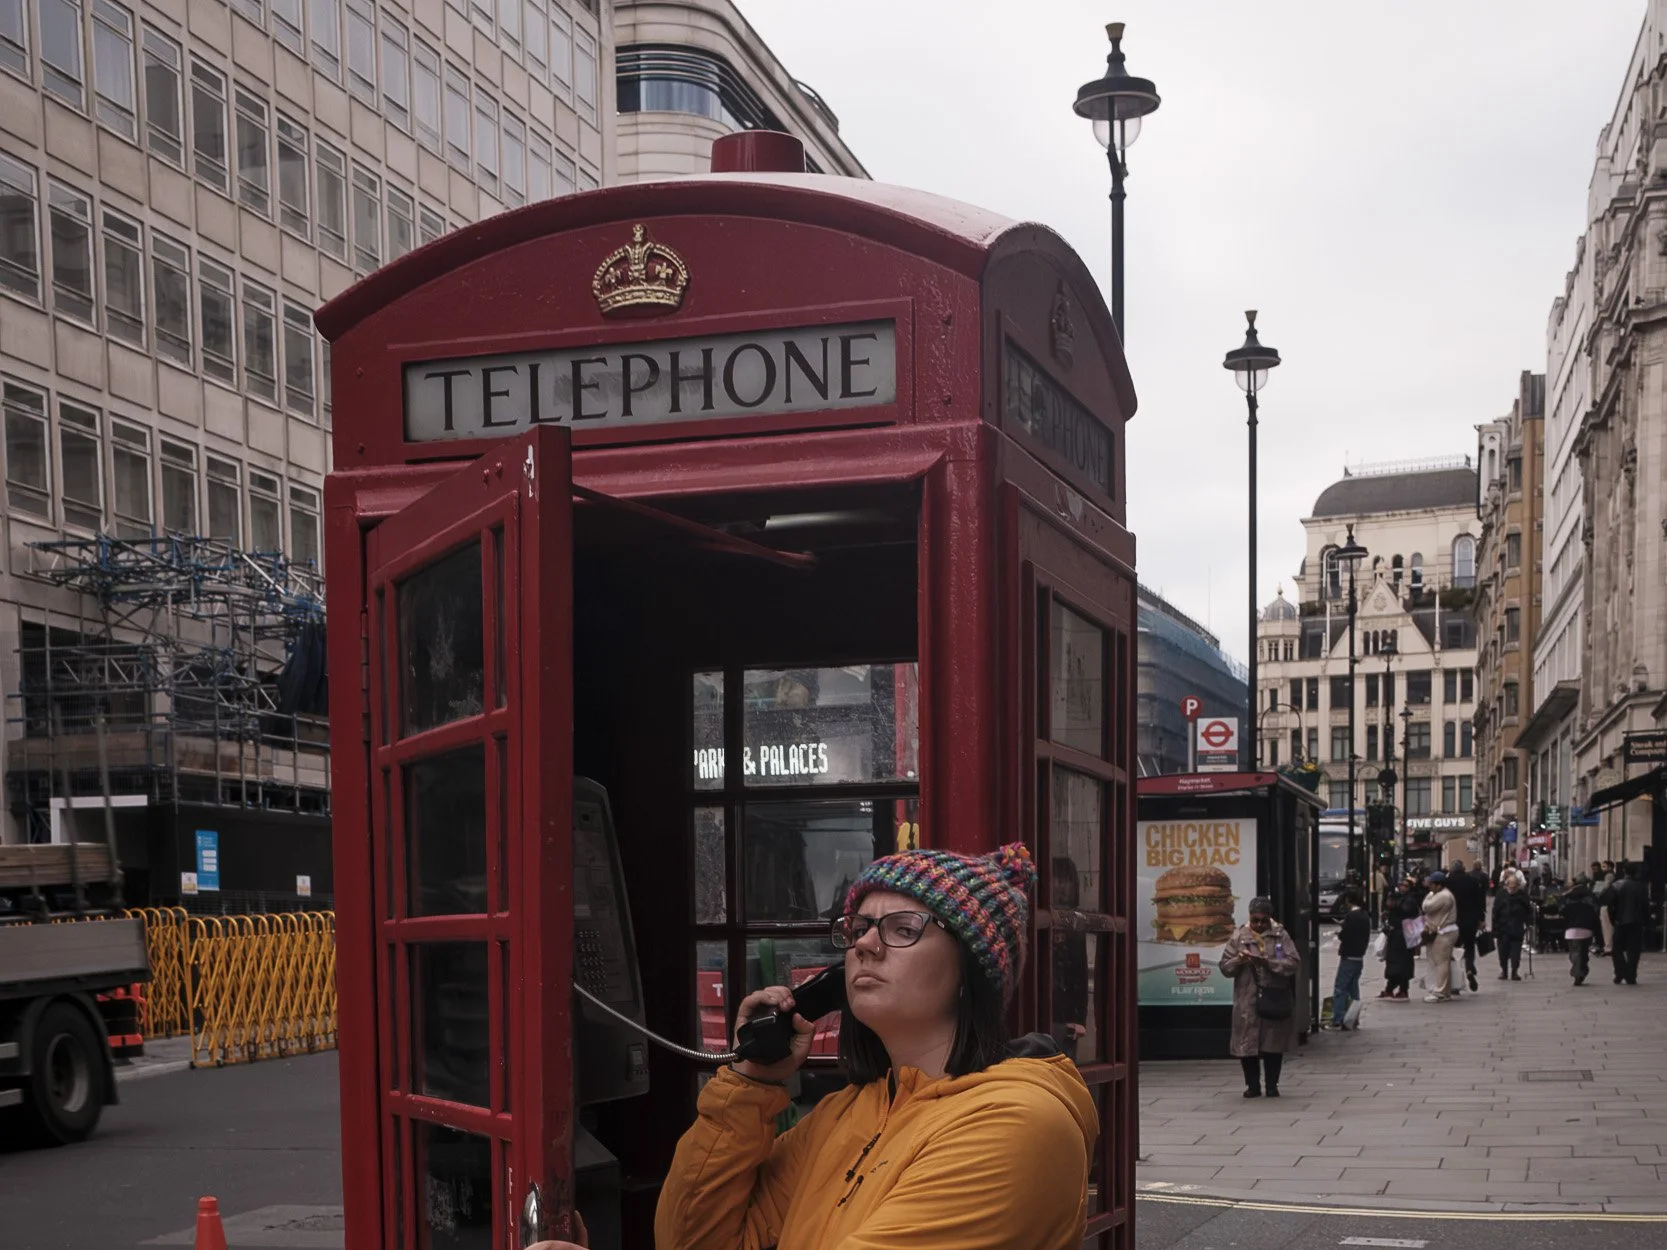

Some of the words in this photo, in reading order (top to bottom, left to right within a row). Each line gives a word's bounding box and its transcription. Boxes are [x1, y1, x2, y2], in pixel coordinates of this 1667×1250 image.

[424, 332, 880, 431] TELEPHONE
[743, 746, 757, 775] &
[760, 743, 829, 776] PALACES
[1145, 822, 1240, 848] CHICKEN
[1406, 818, 1432, 828] FIVE
[1434, 817, 1466, 828] GUYS
[1189, 846, 1240, 866] MAC
